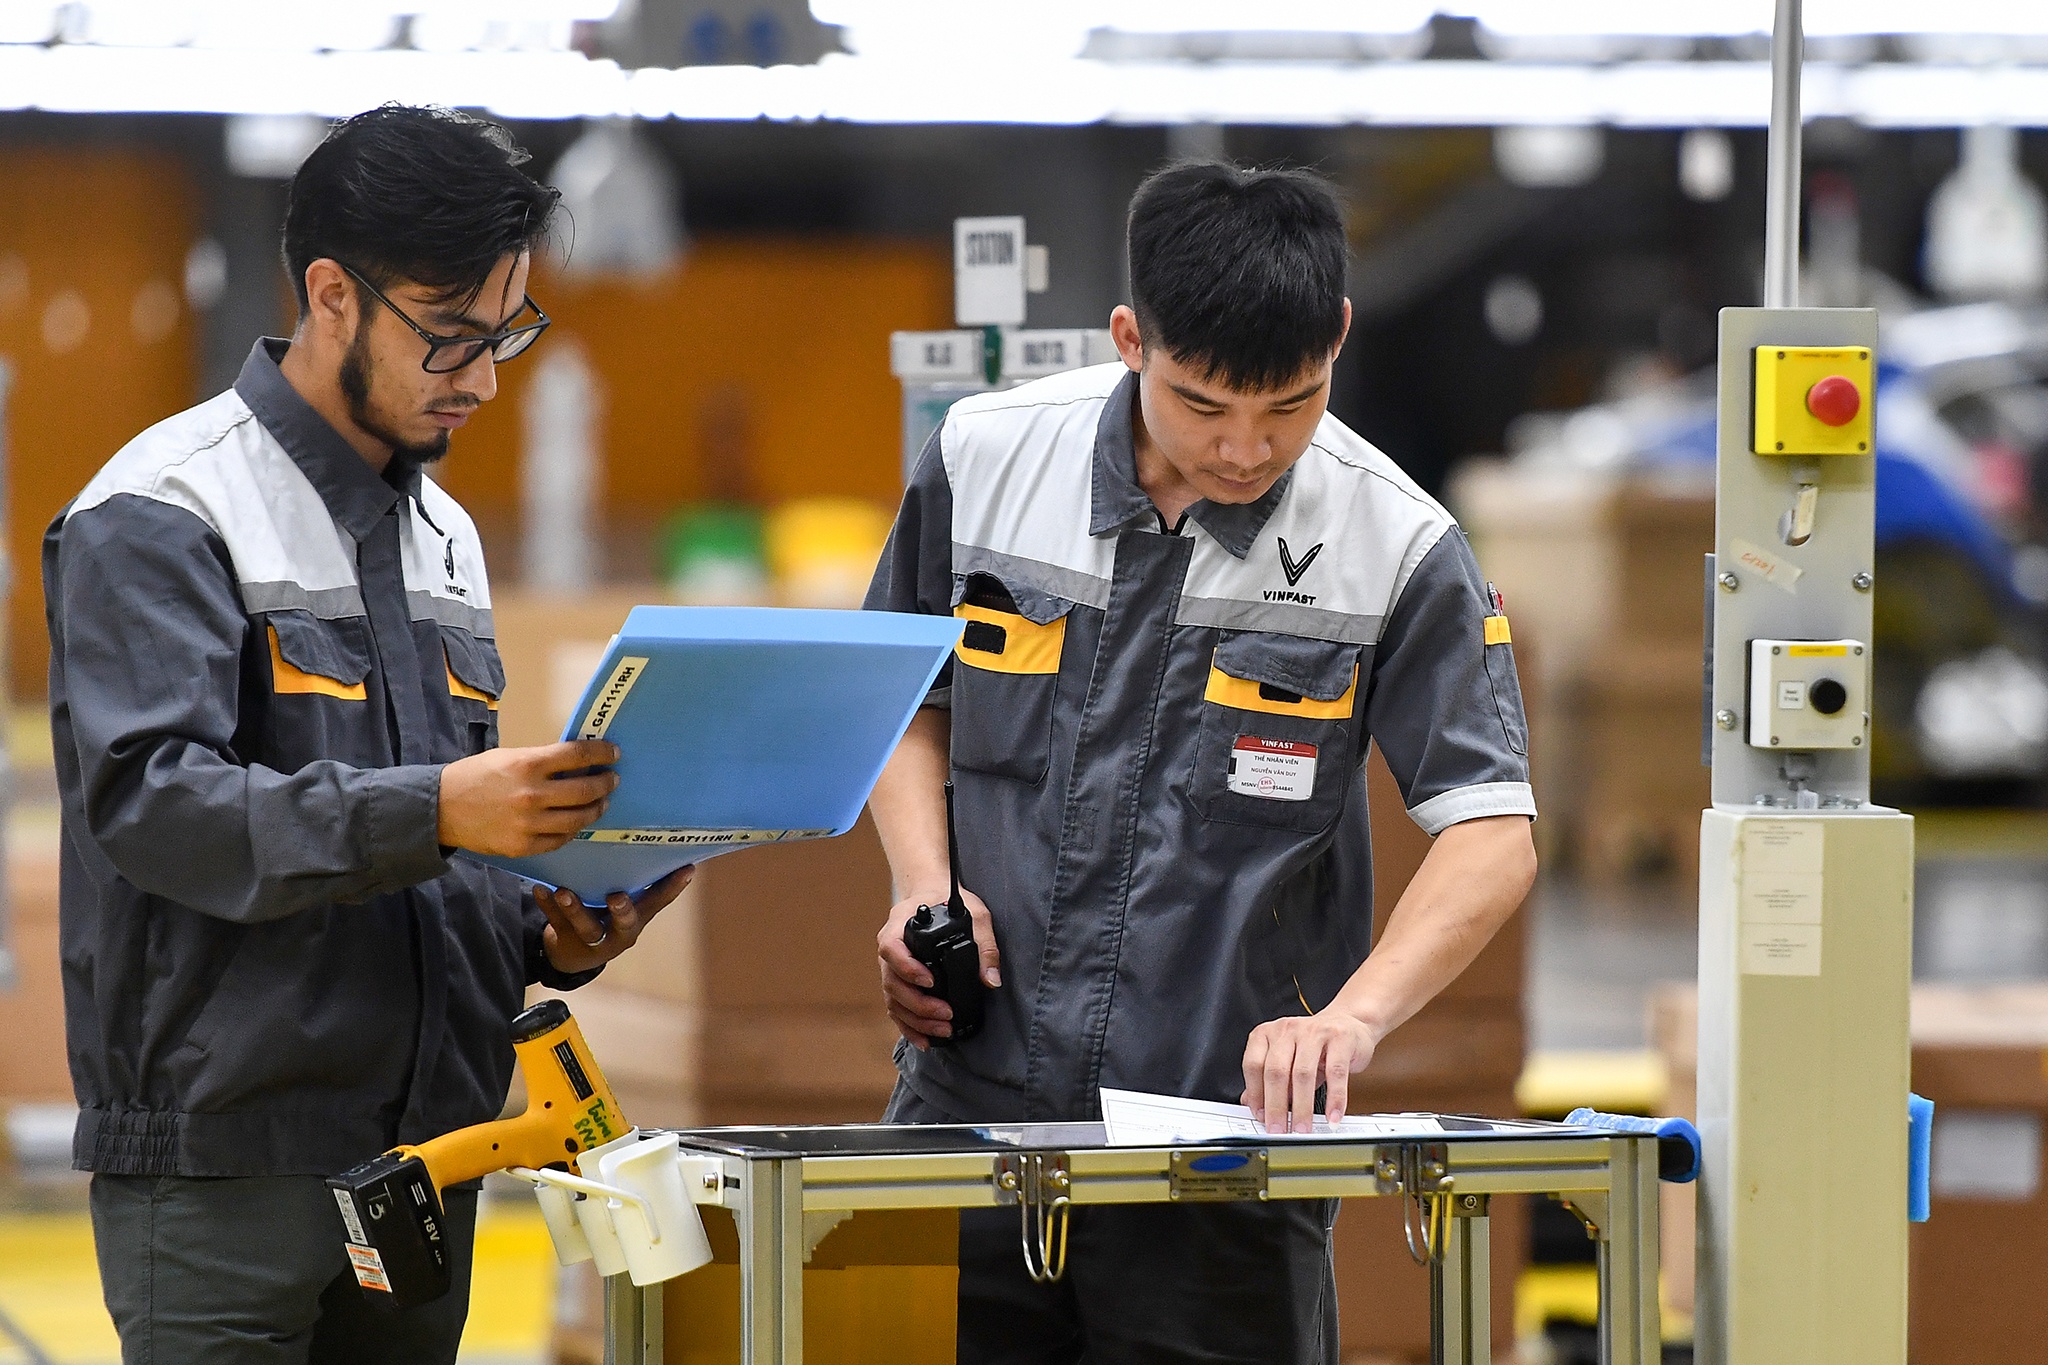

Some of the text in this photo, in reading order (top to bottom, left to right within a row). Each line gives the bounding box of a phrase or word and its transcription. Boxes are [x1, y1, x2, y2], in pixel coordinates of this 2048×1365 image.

[1263, 590, 1317, 606] VINFAST
[1261, 740, 1294, 749] VINFAST
[423, 1215, 440, 1241] 18V
